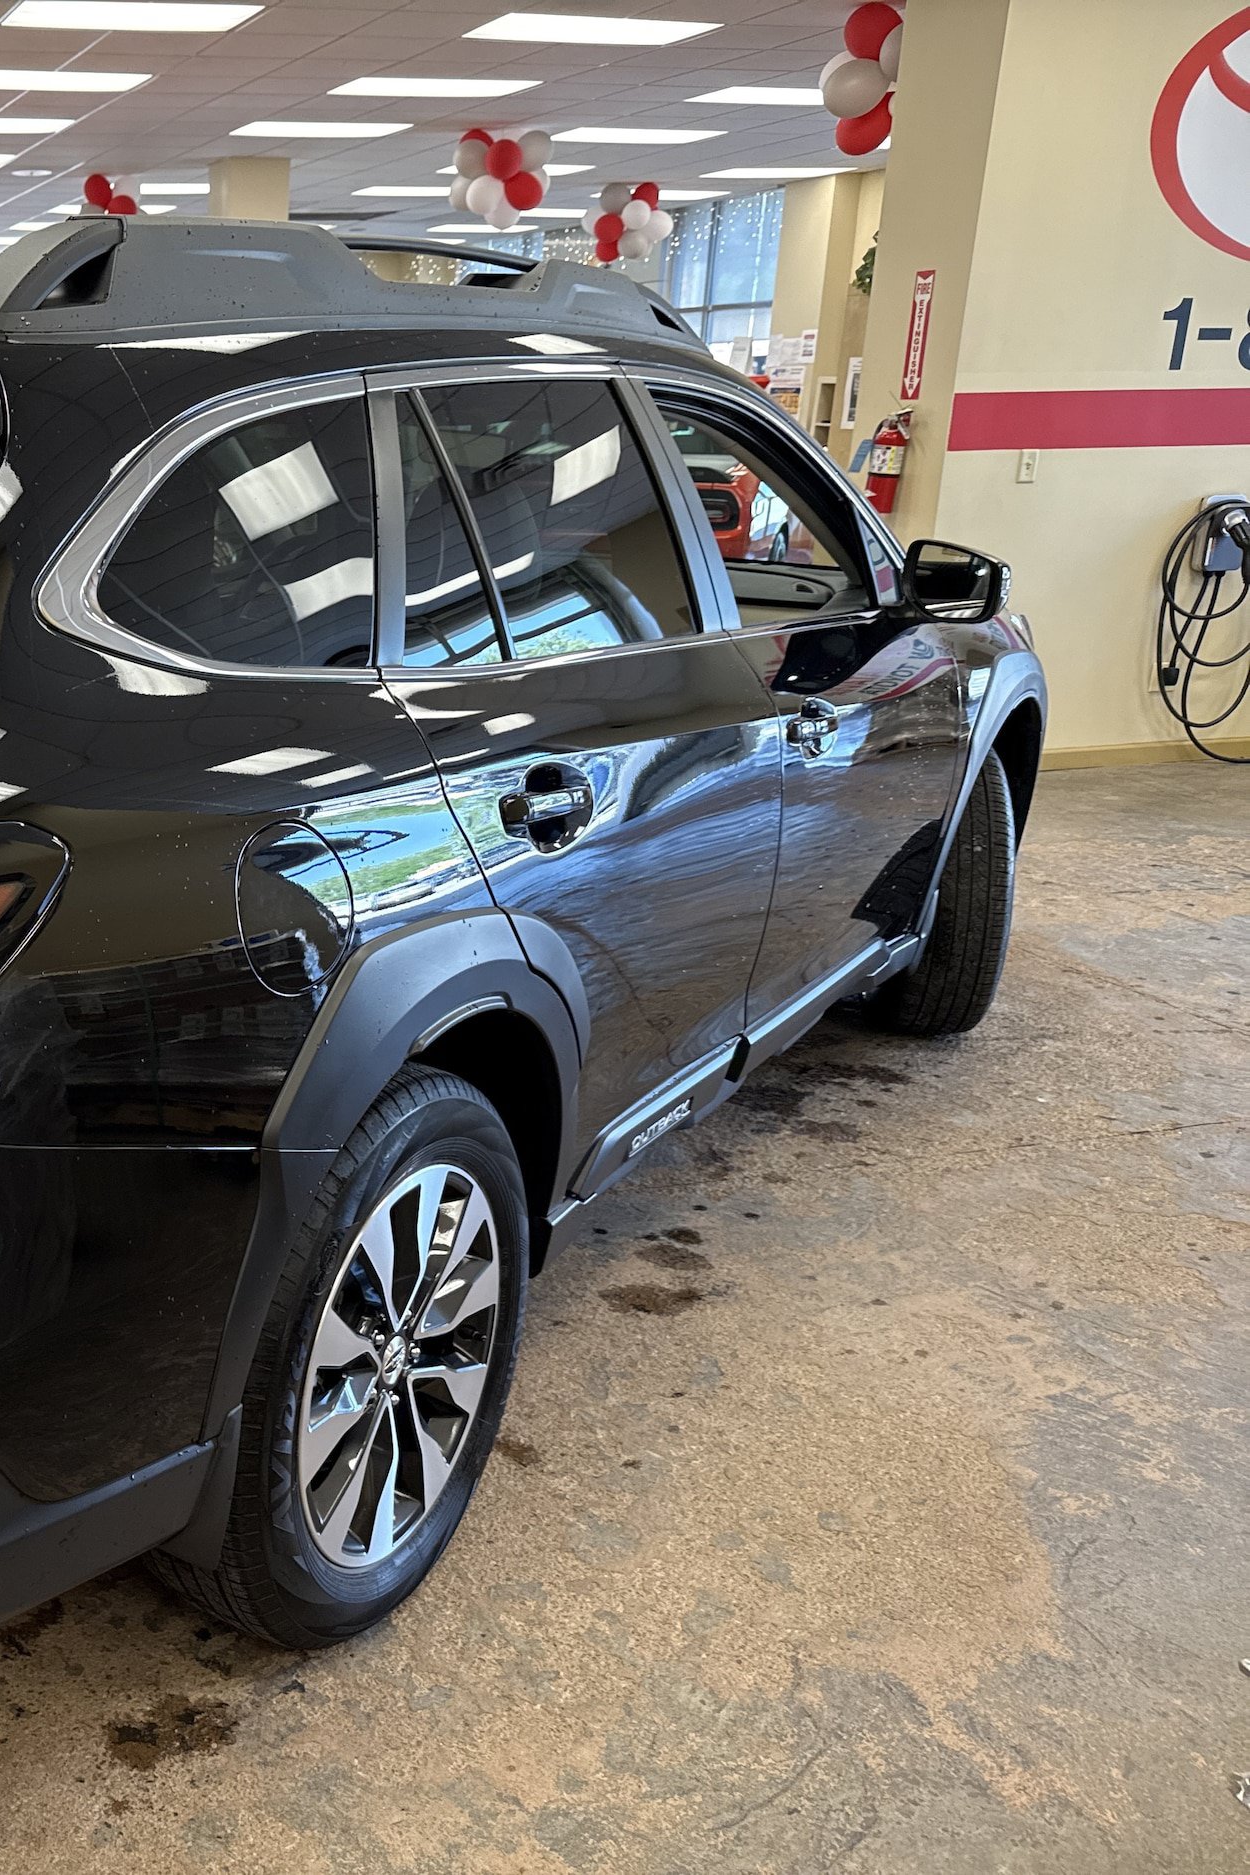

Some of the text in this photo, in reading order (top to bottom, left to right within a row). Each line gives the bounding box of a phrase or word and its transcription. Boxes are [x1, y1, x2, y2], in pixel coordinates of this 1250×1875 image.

[916, 282, 931, 295] FIRE
[908, 299, 925, 390] EXTINGUISHER
[631, 1098, 692, 1150] OUTBACK
